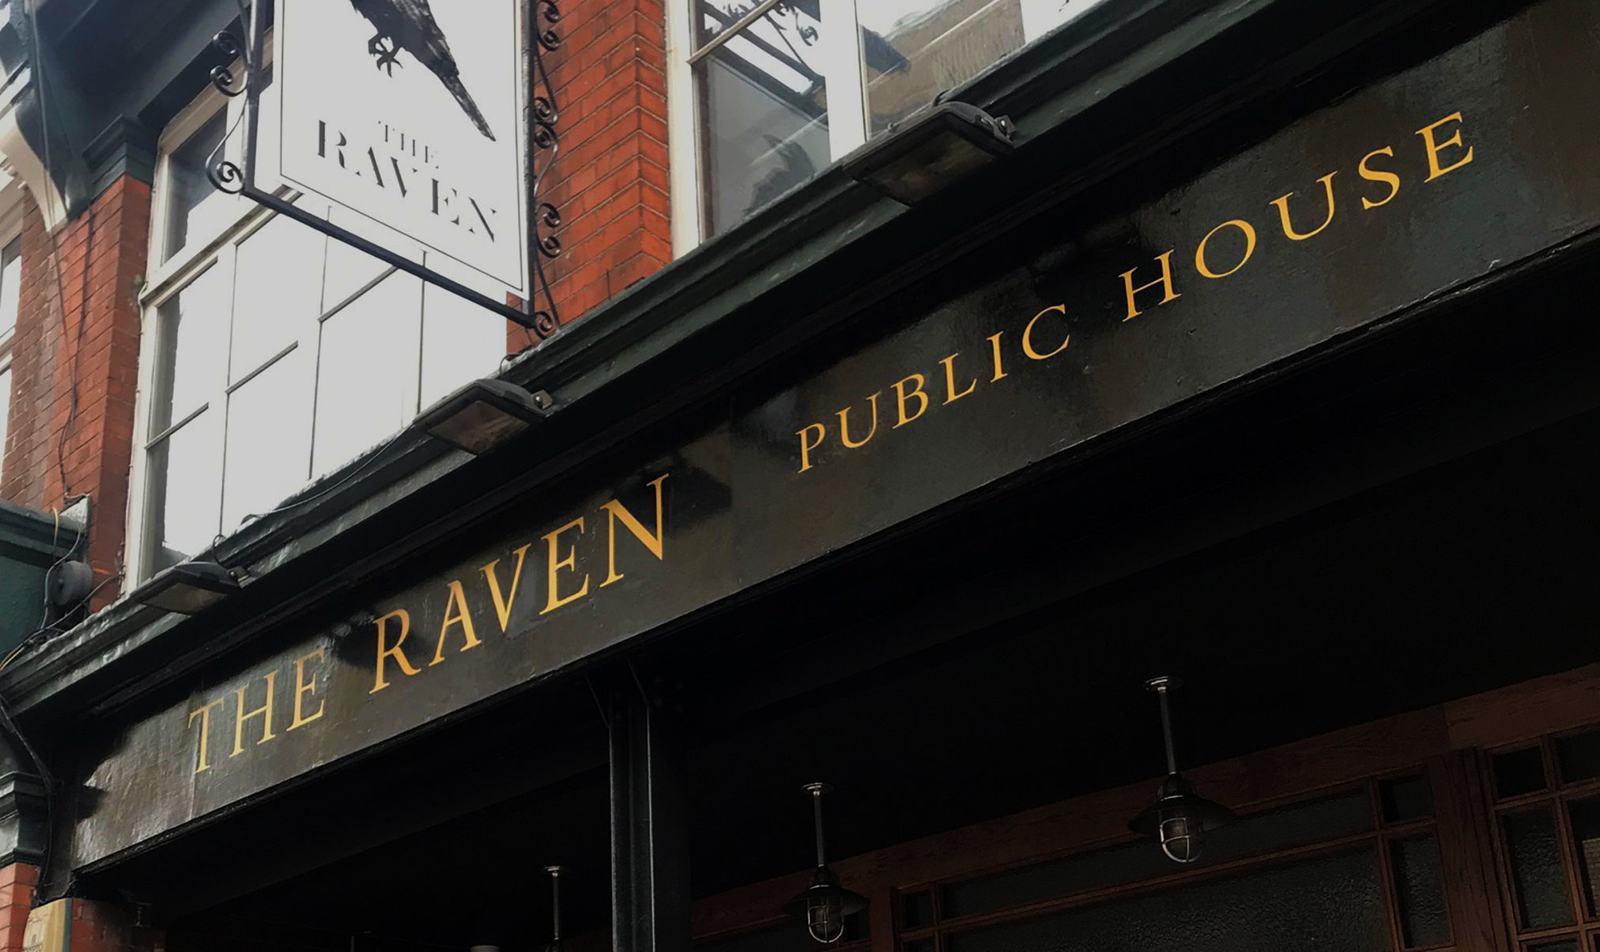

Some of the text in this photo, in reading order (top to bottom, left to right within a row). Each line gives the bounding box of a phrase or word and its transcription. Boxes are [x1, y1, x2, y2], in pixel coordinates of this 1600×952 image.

[317, 119, 498, 244] RAVEN
[377, 120, 440, 170] THE
[188, 111, 1475, 775] THE RAVEN PUBLIC HOUSE
